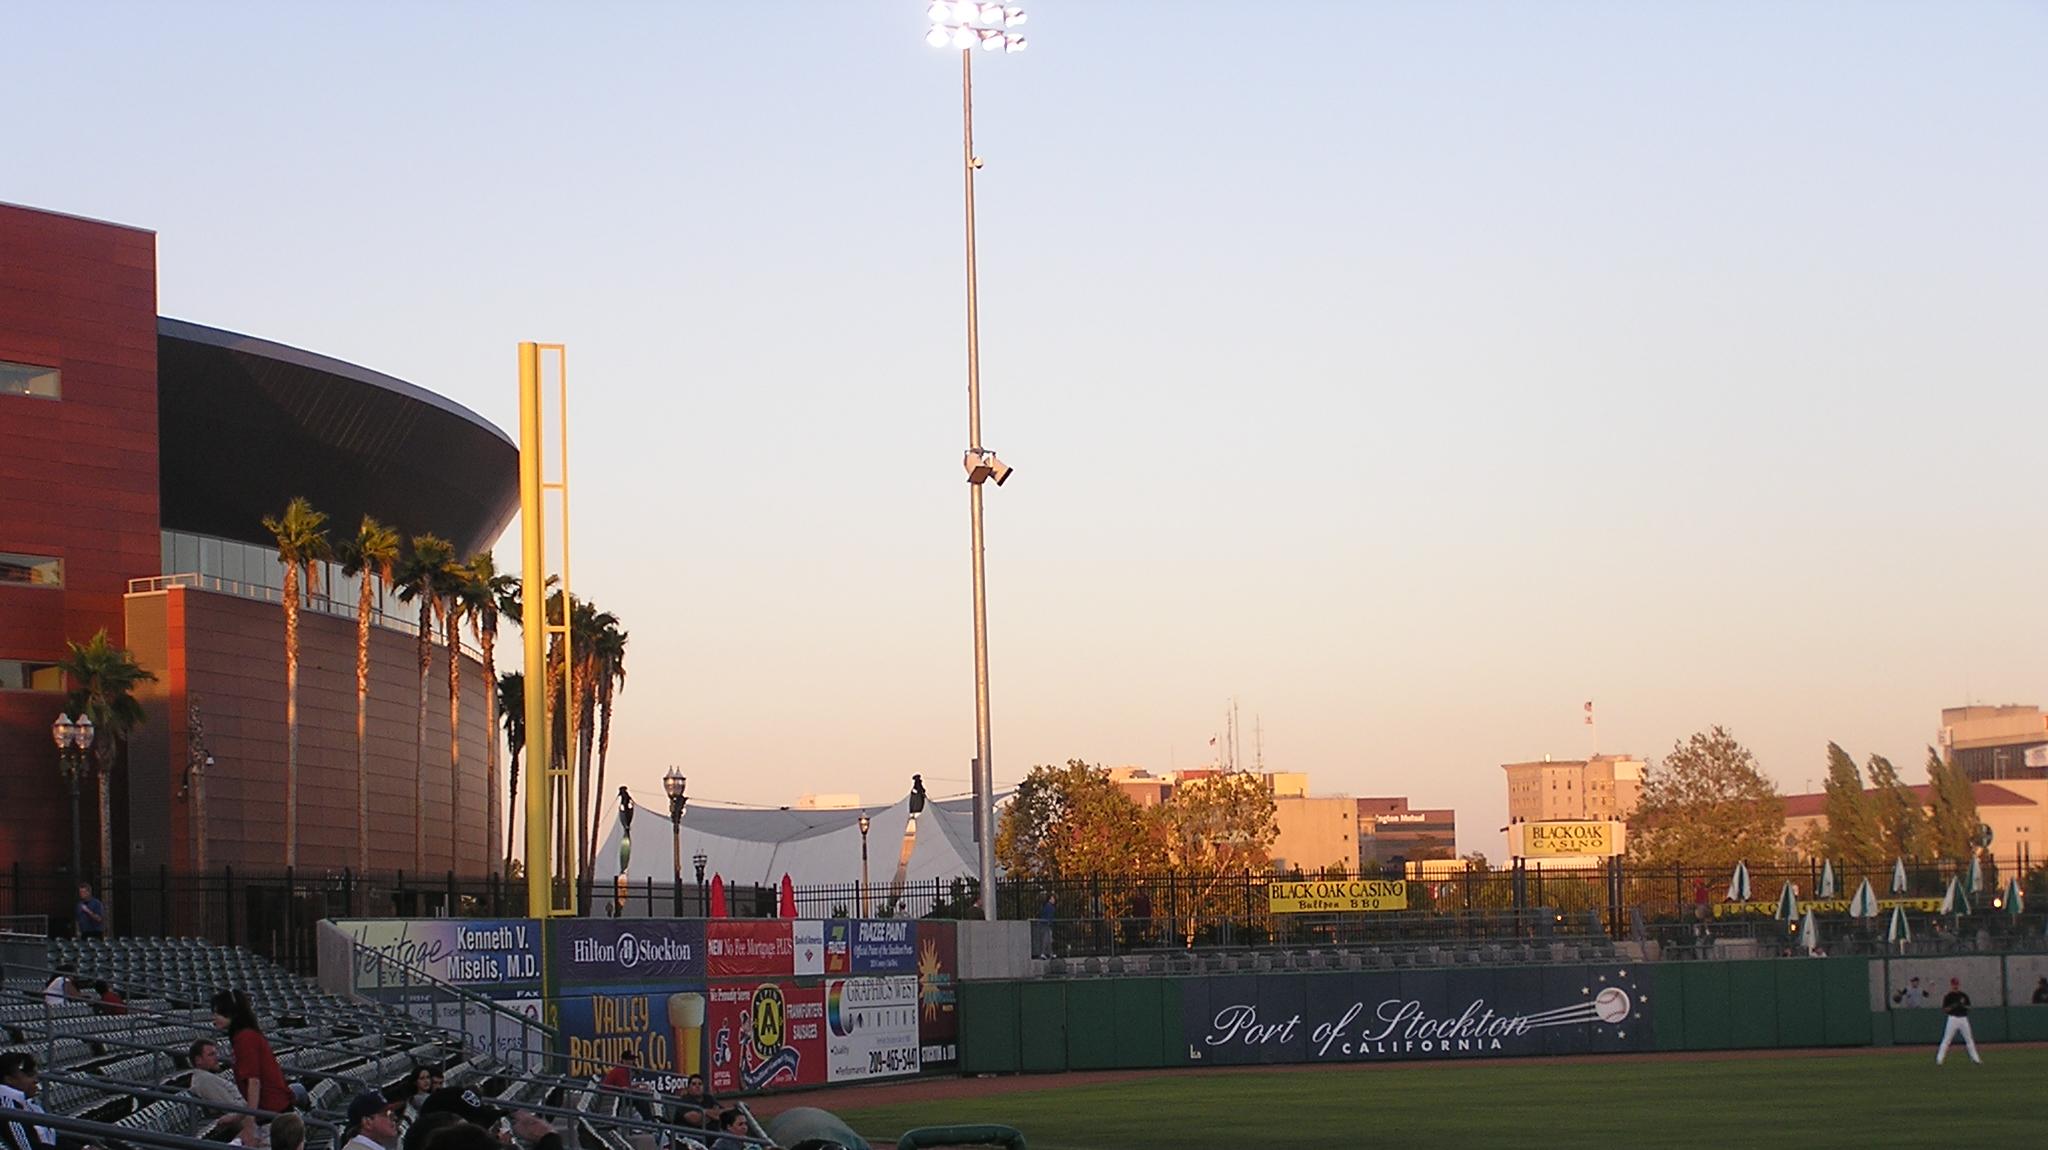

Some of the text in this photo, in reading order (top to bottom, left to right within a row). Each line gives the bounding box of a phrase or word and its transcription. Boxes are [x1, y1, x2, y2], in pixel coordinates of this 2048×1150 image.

[1532, 825, 1603, 839] BLACK OAK
[1533, 839, 1603, 849] CASINO
[1271, 881, 1404, 900] BLACK OAK CASINO
[1299, 900, 1340, 911] Bullpen
[457, 925, 529, 951] Kenneth V.
[859, 922, 907, 942] FRAZEE PAINT
[574, 938, 615, 962] Hilton
[639, 937, 691, 961] Stockton
[707, 937, 793, 959] NEW No Fee Mortgage PLUS
[447, 955, 503, 982] Miselis,
[508, 954, 540, 978] M.D.
[516, 990, 540, 998] FAX
[709, 988, 718, 1001] We
[718, 988, 737, 1004] Proudly
[846, 979, 893, 1002] GRAPHICS
[893, 976, 916, 1000] WEST
[592, 995, 649, 1034] VALLEY
[793, 1024, 818, 1040] SAUSAGES
[1205, 999, 1532, 1056] Port of Stockton
[650, 1032, 672, 1072] CO.
[1342, 1038, 1502, 1055] CALIFORNIA
[657, 1076, 664, 1091] &
